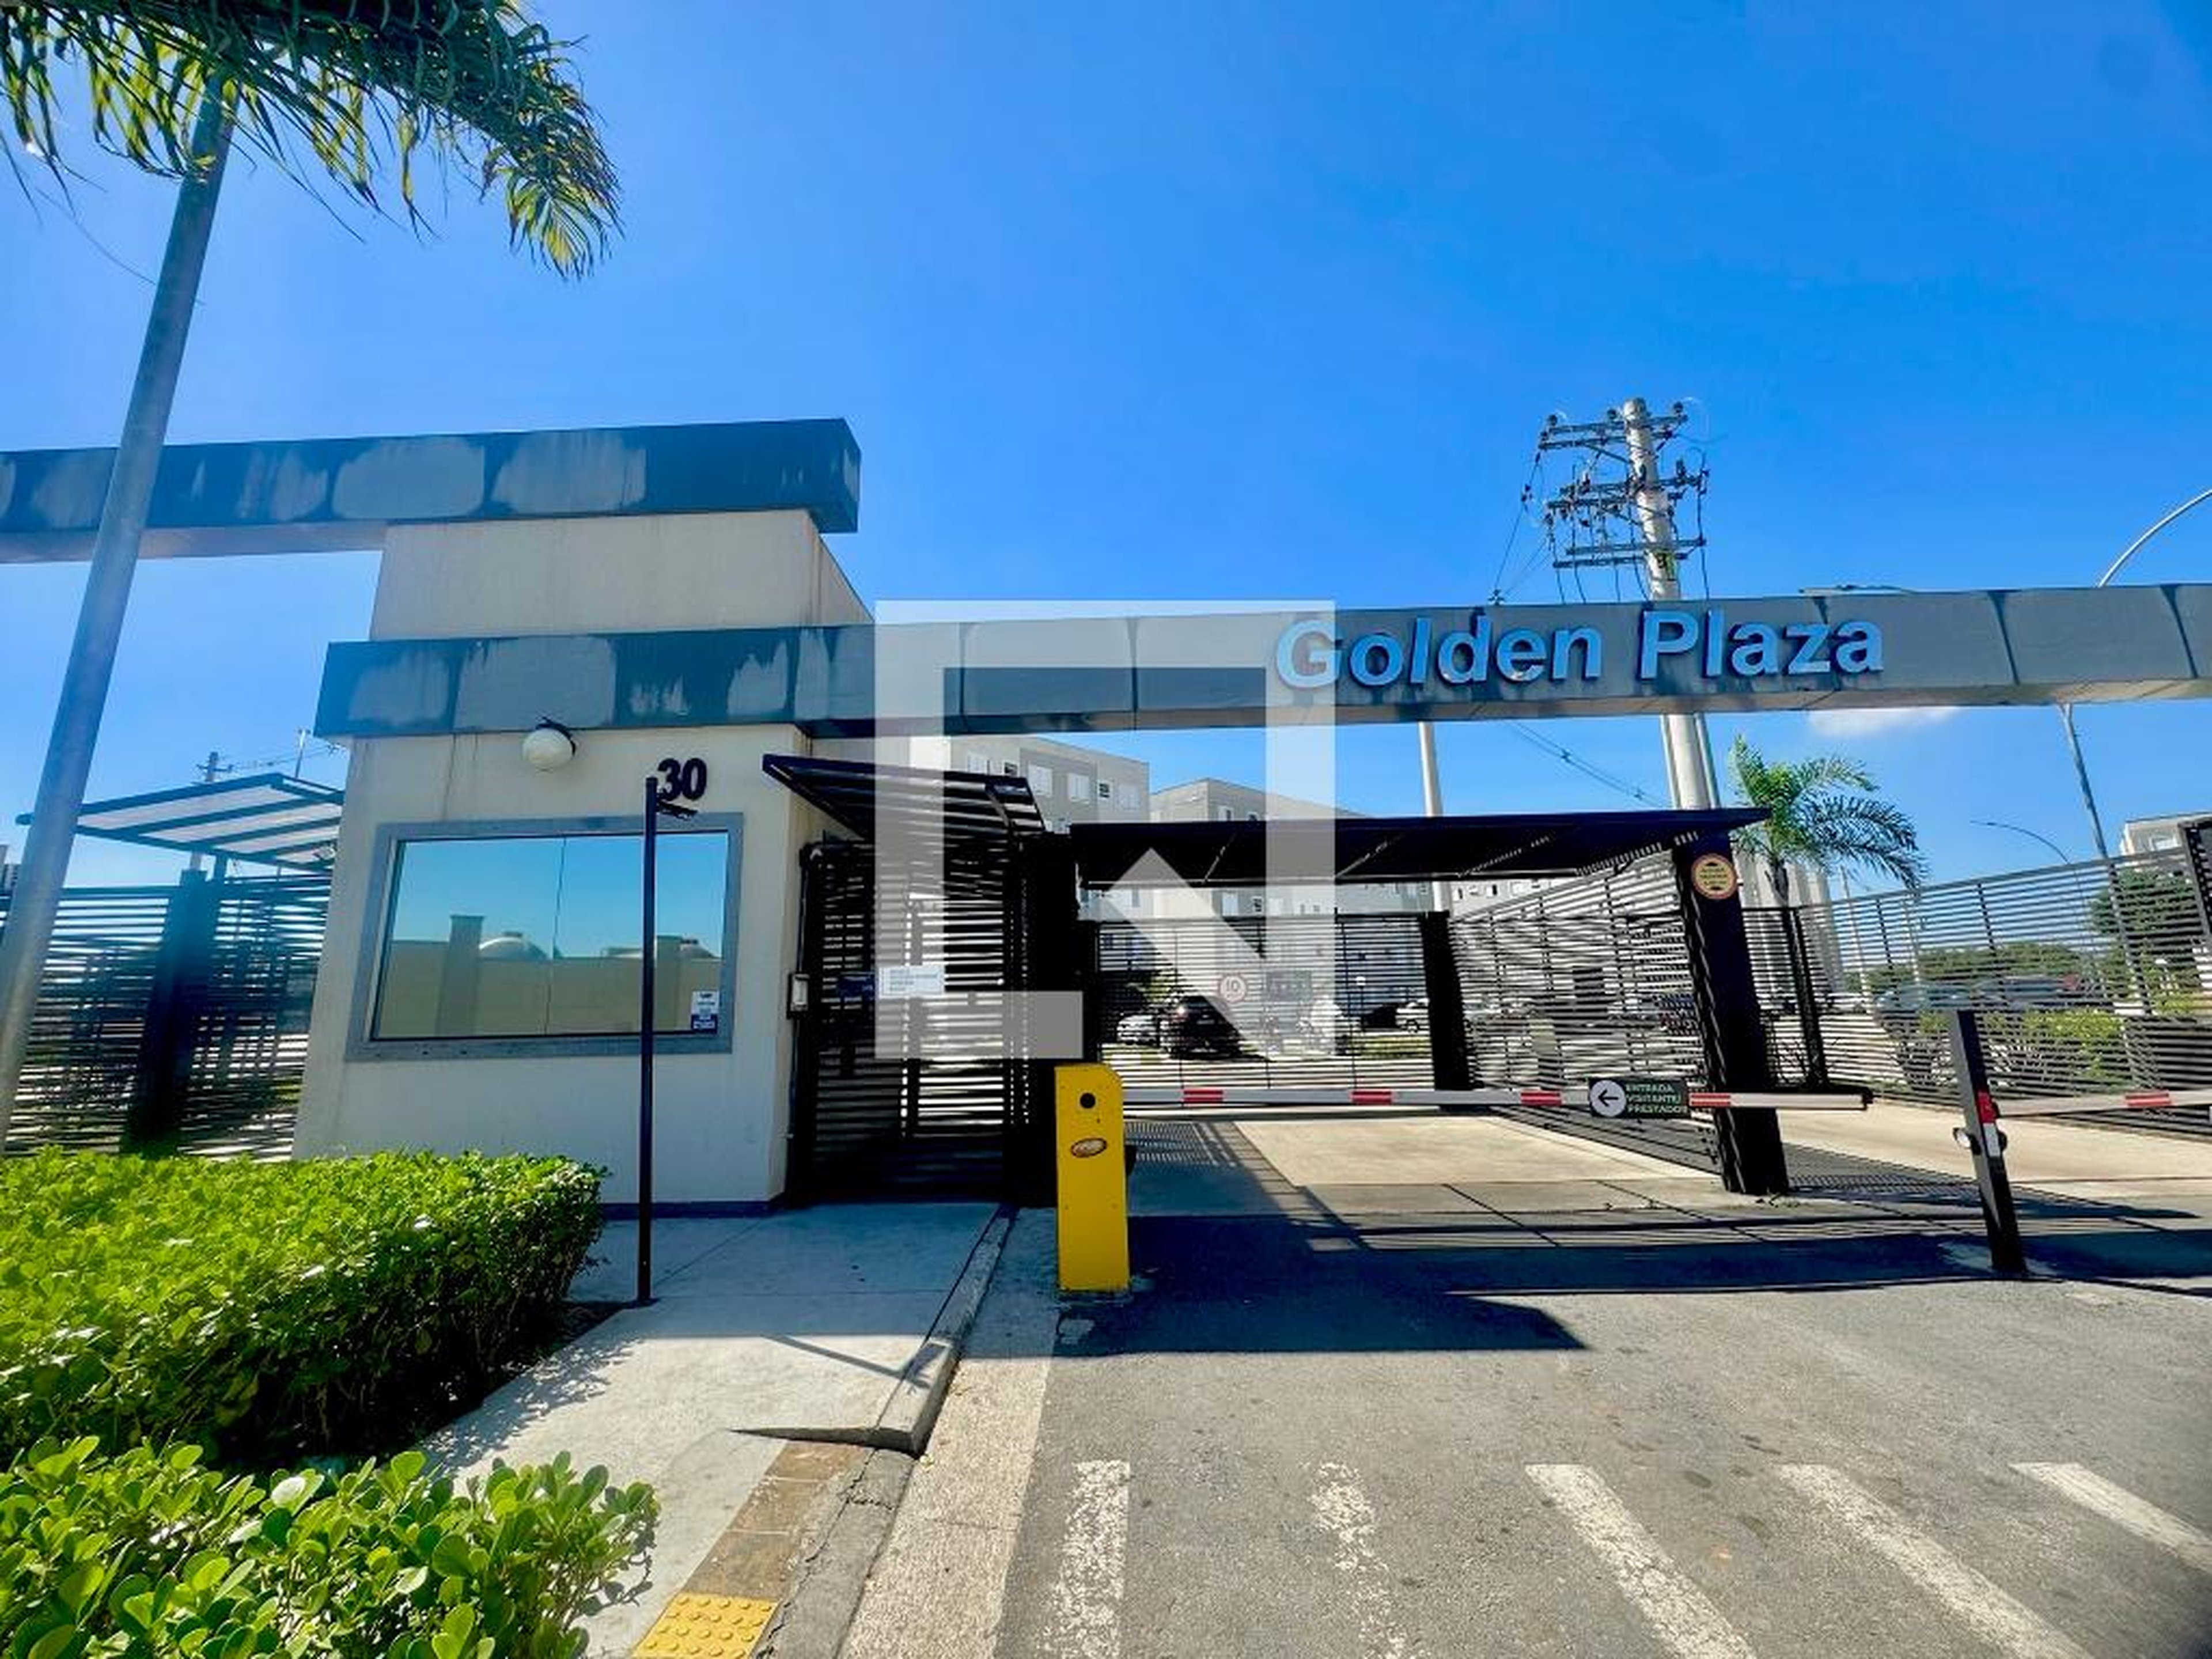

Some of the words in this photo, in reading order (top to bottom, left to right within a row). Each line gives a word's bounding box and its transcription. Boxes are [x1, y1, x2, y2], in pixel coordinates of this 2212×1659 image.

[1275, 613, 1603, 690] Golden
[1638, 609, 1885, 680] Plaza
[657, 757, 707, 801] 30
